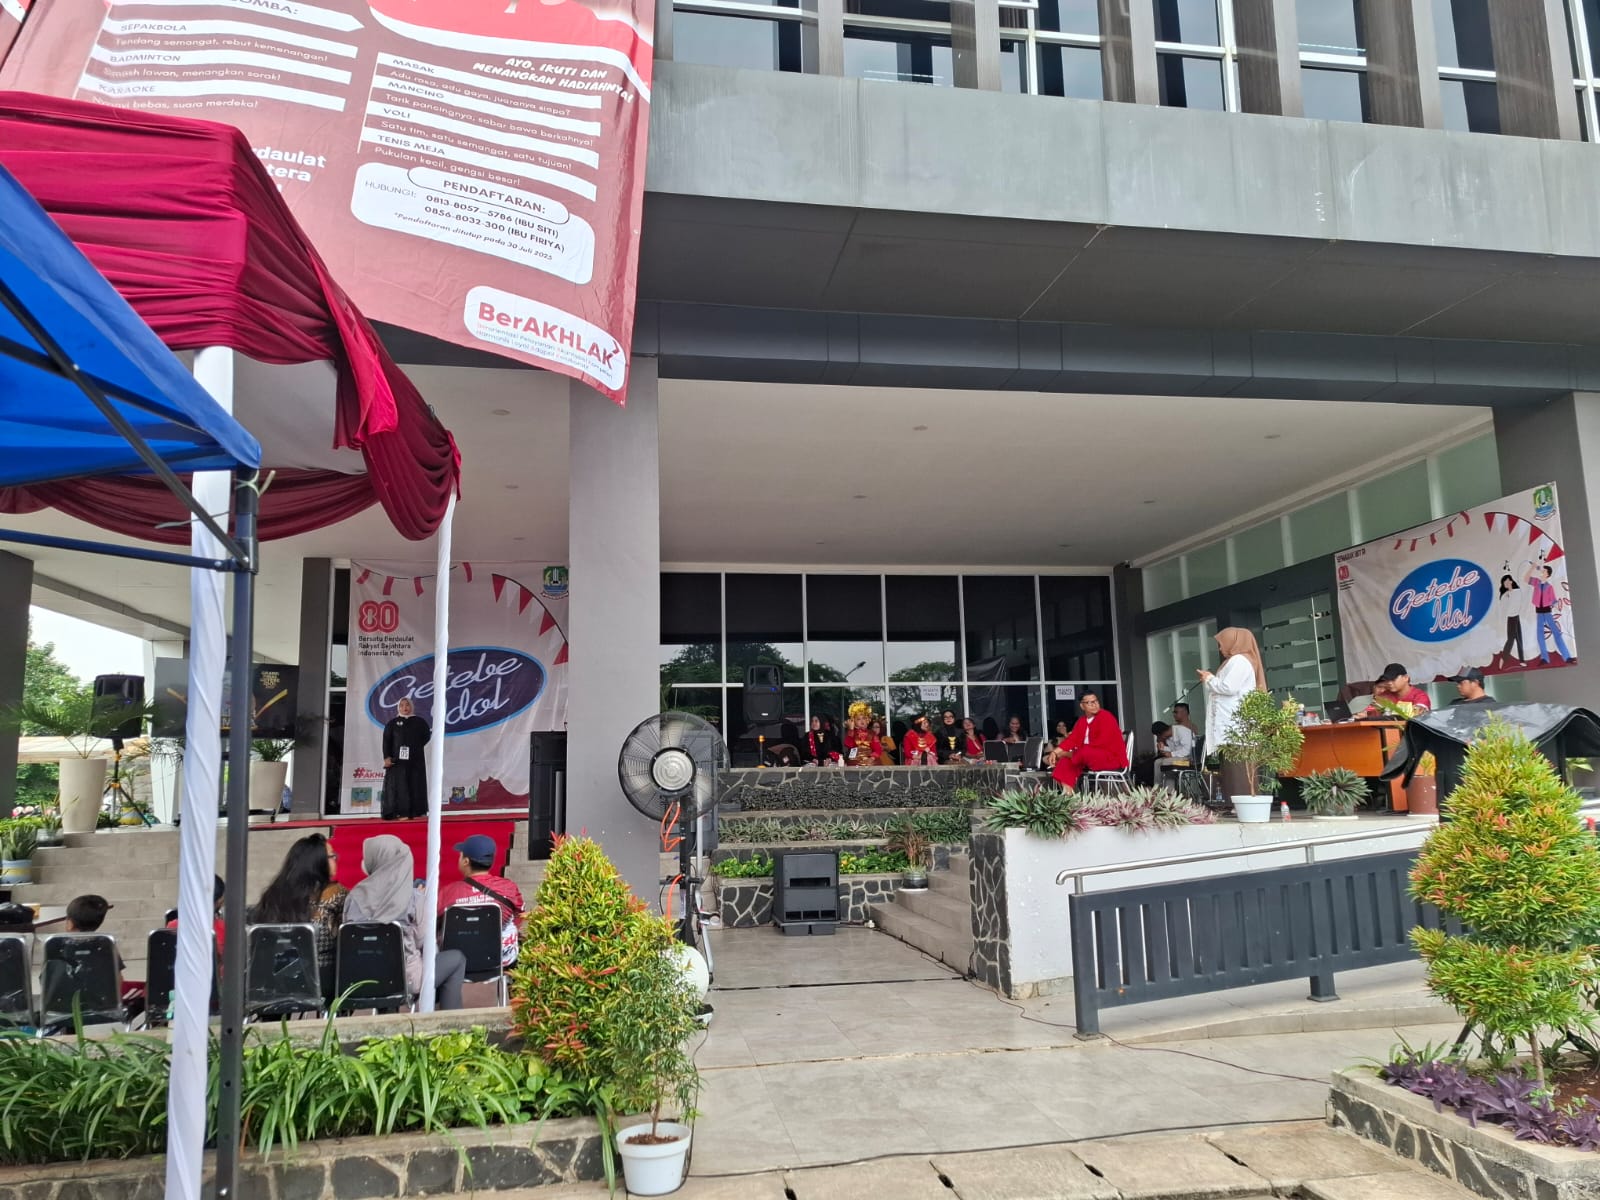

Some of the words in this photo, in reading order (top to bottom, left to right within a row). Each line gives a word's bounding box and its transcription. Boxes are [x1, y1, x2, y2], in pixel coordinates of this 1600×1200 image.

[120, 23, 187, 32] SEPAKBOLA
[110, 54, 181, 63] BADMINTON
[115, 37, 161, 47] Tendang
[222, 39, 252, 47] rebut
[254, 41, 328, 62] kemenangan!
[103, 67, 140, 78] Smash
[142, 68, 179, 78] lawan,
[182, 68, 244, 77] menangkan
[247, 70, 281, 80] sorak!
[392, 59, 435, 74] MASAK
[539, 63, 578, 78] IKUTI
[580, 69, 608, 79] DAN
[98, 84, 156, 94] KARAOKE
[390, 70, 411, 81] Adu
[441, 83, 461, 93] adu
[493, 95, 536, 110] juaranya
[538, 104, 571, 117] siapa?
[472, 63, 556, 85] MENANGKAN
[558, 78, 635, 104] HADIAHNYA!
[133, 100, 170, 109] bebas,
[206, 99, 258, 108] merdeka!
[383, 107, 411, 119] VOLI
[385, 93, 410, 105] Tarik
[478, 115, 507, 129] sabar
[509, 123, 538, 135] bawa
[540, 128, 593, 147] berkahnya!
[378, 134, 411, 148] TENIS
[413, 143, 445, 155] MEJA
[381, 121, 406, 133] Satu
[431, 133, 455, 144] satu
[513, 151, 535, 162] satu
[538, 155, 572, 171] tujuan!
[374, 146, 417, 162] Pukulan
[420, 156, 448, 169] kecil,
[450, 164, 485, 178] gengsi
[488, 173, 522, 186] besar!
[364, 180, 417, 199] HUBUNGI:
[443, 180, 546, 214] PENDAFTARAN:
[424, 206, 505, 232] 0856-8032-300
[507, 226, 528, 239] (IBU
[530, 234, 565, 253] FIRIYA)
[514, 216, 535, 229] (IBU
[537, 224, 560, 239] SITI)
[452, 228, 482, 240] ditutup
[483, 236, 506, 246] pada
[506, 241, 518, 249] 30
[518, 246, 533, 255] Juli
[534, 250, 553, 261] 2025
[478, 302, 616, 370] BerAKHLAK
[1392, 565, 1480, 620] Getebe
[358, 599, 400, 634] 80
[1429, 589, 1473, 633] Idol
